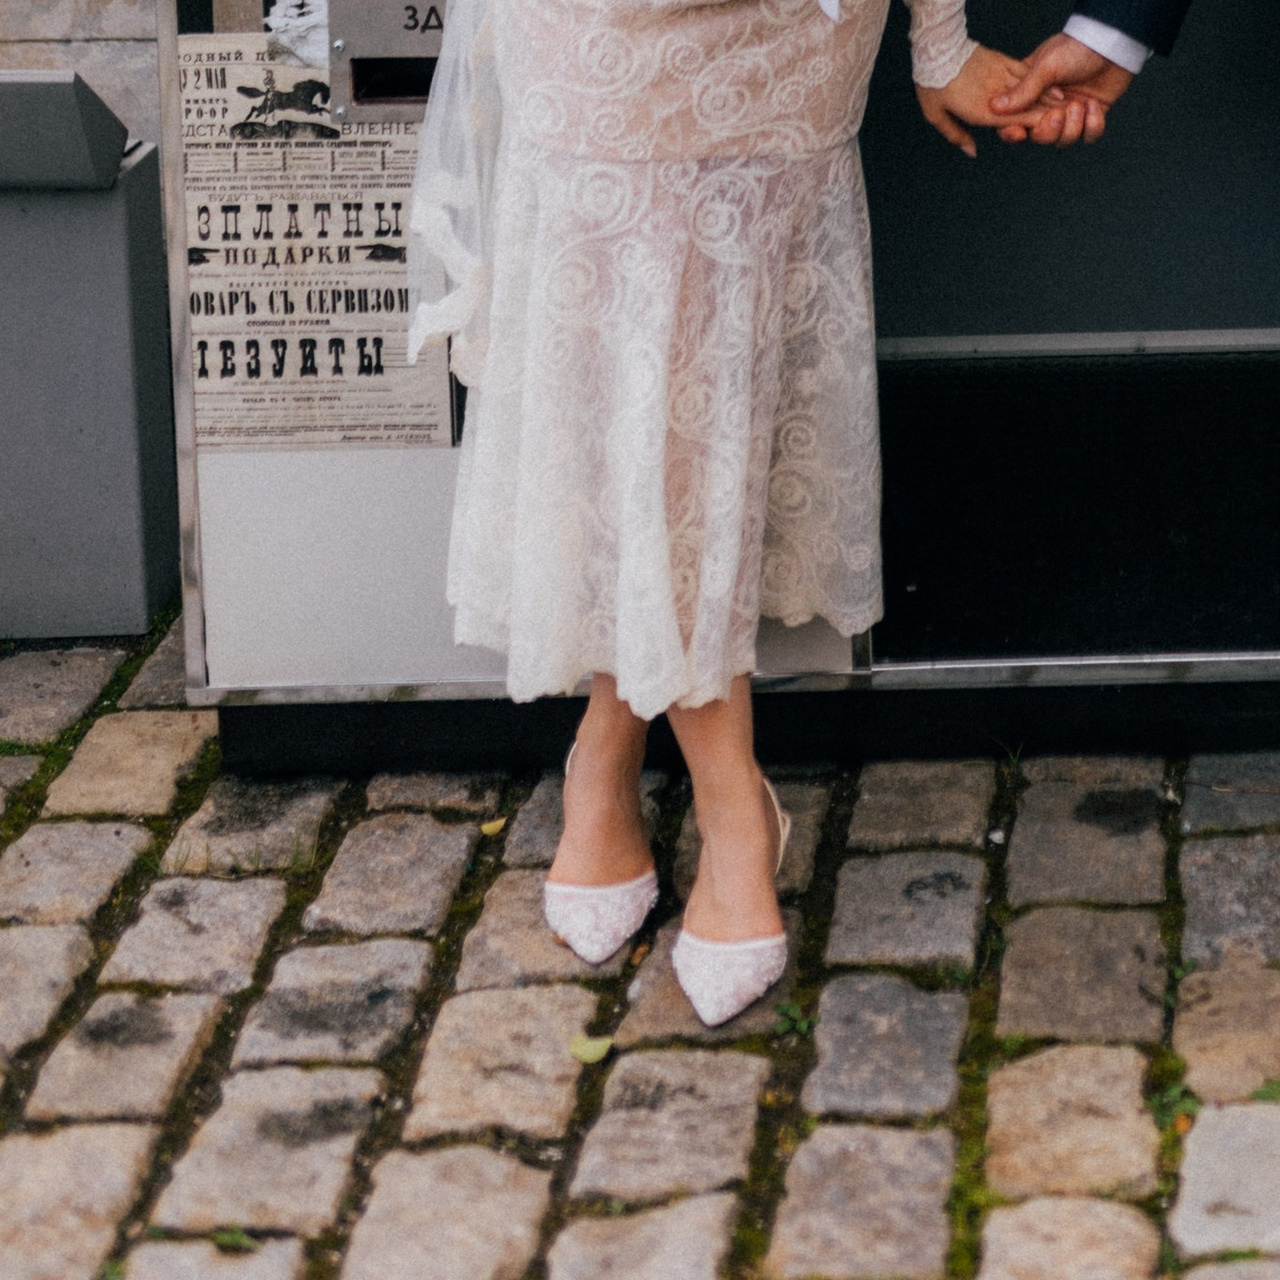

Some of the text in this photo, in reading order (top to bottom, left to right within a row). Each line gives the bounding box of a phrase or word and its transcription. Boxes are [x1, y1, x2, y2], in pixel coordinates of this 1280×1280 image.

[178, 49, 243, 63] ОДНЫЙ
[194, 68, 201, 90] 2
[197, 202, 403, 241] ЗПЛАТНЫ
[224, 245, 352, 269] ПОДАРКИ
[268, 290, 295, 315] СЪ
